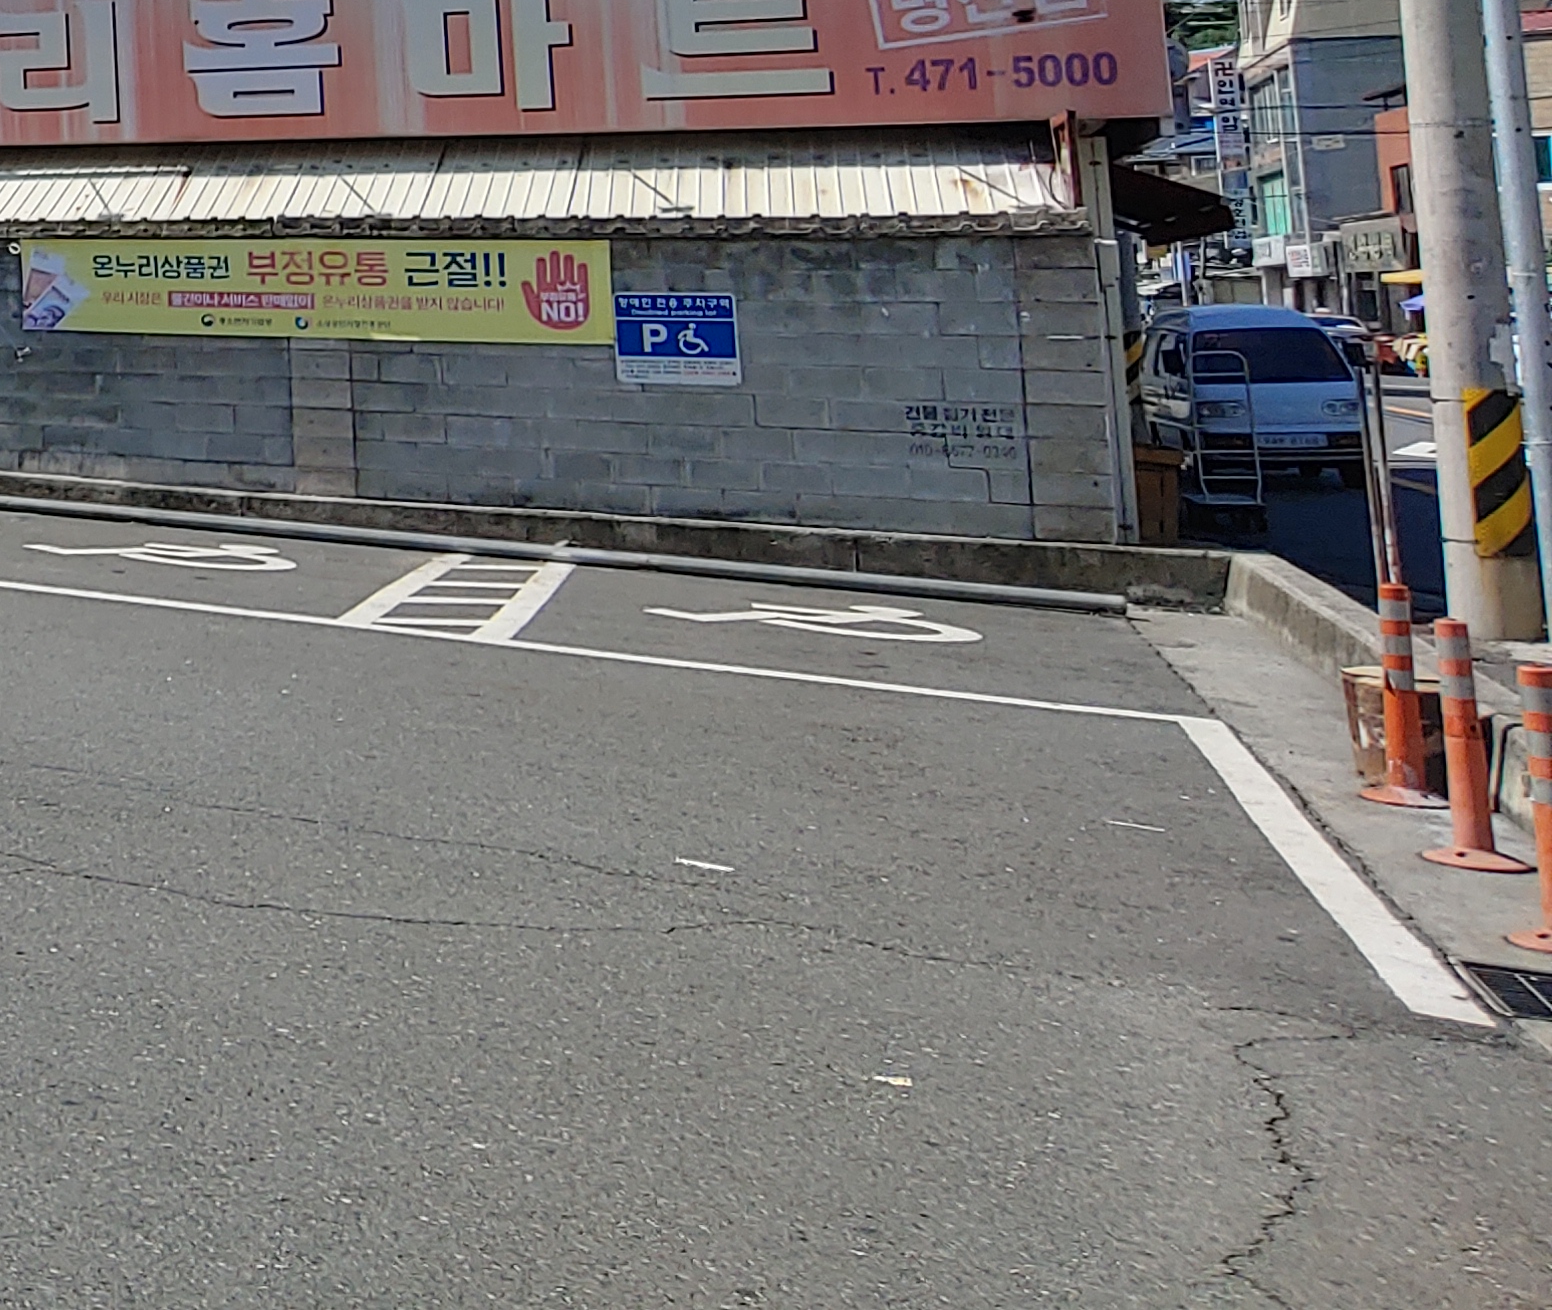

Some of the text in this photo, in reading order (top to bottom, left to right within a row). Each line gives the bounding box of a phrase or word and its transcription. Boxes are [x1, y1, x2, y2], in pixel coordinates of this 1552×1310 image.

[92, 251, 507, 288] 온누리상품권 부정유통 근절!!
[101, 291, 124, 305] 우리
[127, 291, 161, 306] 시장은
[170, 292, 218, 307] 물건이나
[221, 293, 260, 308] 서비스
[322, 294, 412, 311] 온누리상품권을
[416, 295, 443, 311] 받지
[447, 296, 505, 312] 않습니다!
[541, 301, 585, 322] NO!
[642, 322, 668, 353] P
